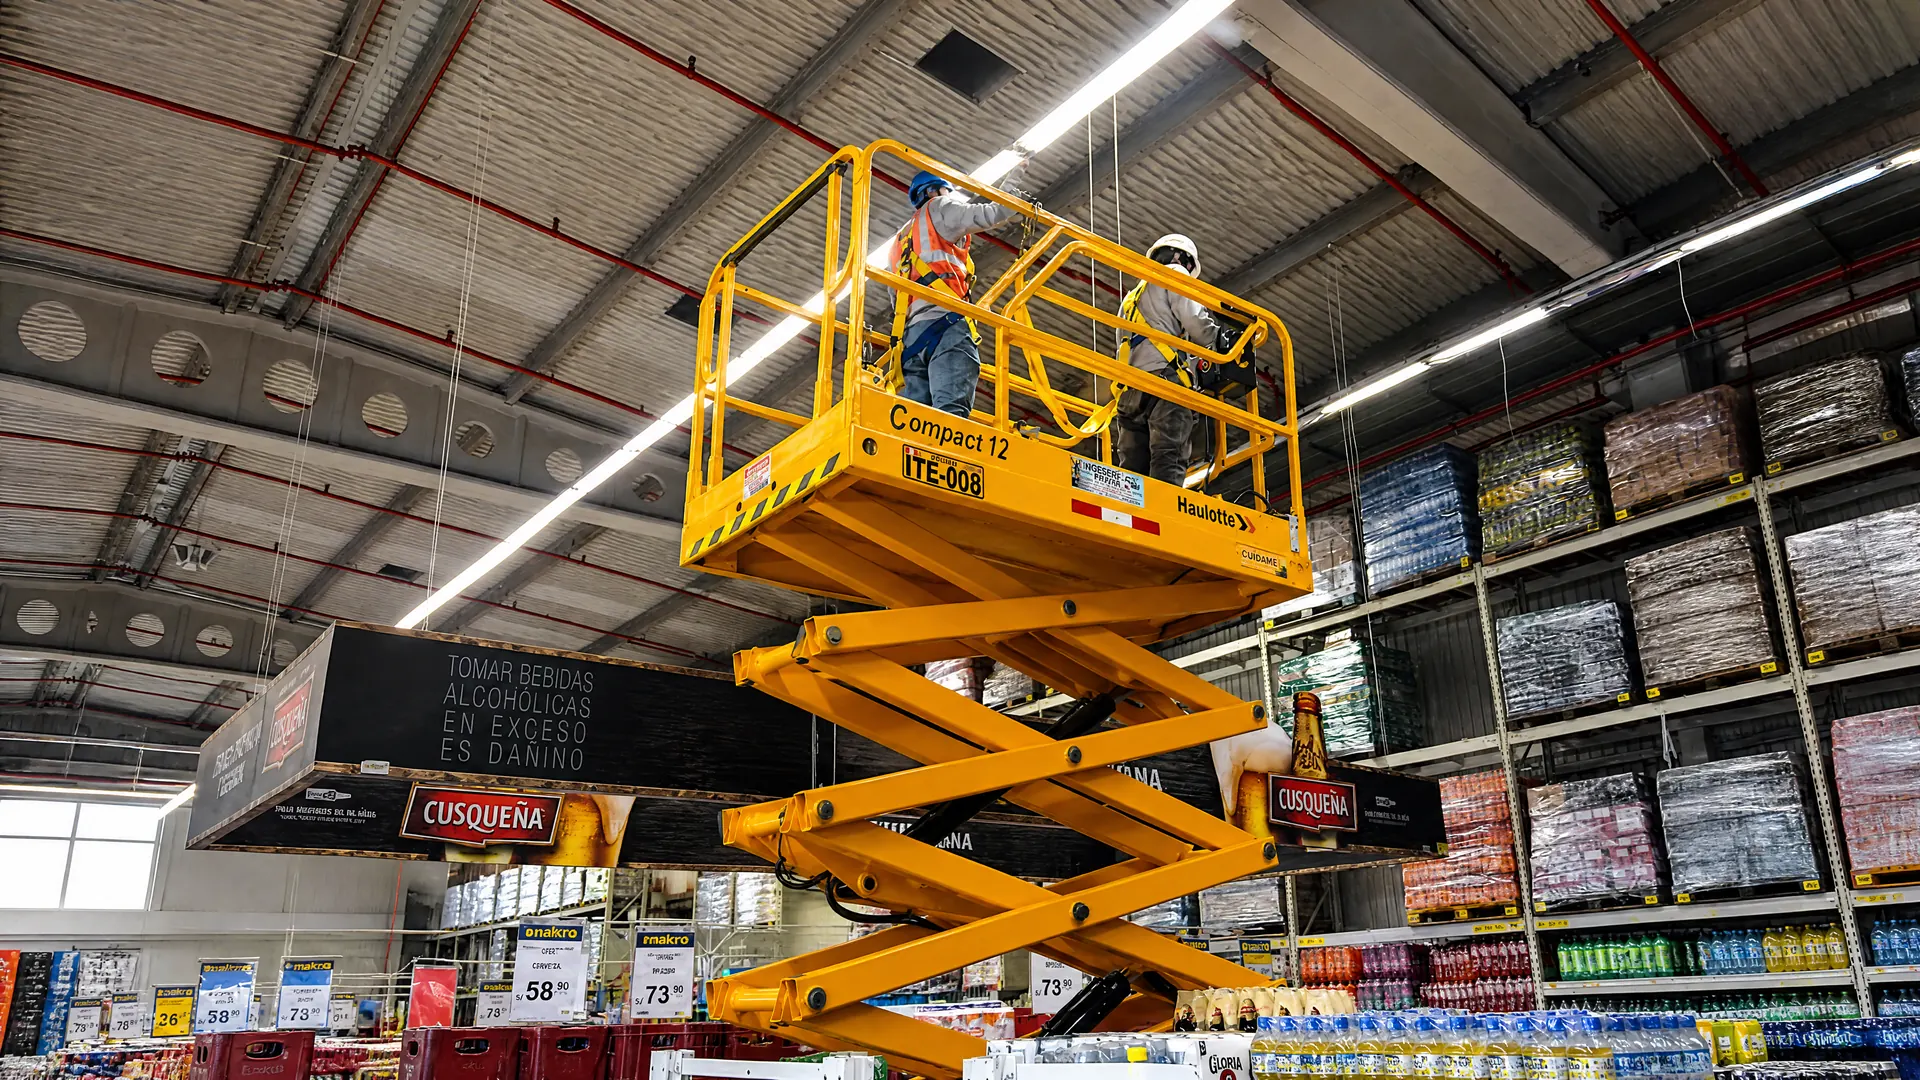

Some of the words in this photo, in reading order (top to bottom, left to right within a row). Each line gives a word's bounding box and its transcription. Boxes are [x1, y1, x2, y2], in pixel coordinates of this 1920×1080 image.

[890, 404, 983, 452] Compact
[990, 435, 1009, 460] 12
[906, 453, 981, 495] ITE-008
[1177, 495, 1235, 528] Haulotte
[1241, 549, 1278, 567] CUIDAME
[448, 654, 513, 683] TOMAR
[519, 663, 594, 693] BEBIDAS
[443, 682, 591, 718] ALCOHÓLICAS
[443, 709, 475, 735] EN
[491, 714, 586, 744] EXCESO
[440, 737, 471, 762] ES
[488, 740, 583, 771] DAÑINO
[423, 800, 544, 834] CUSQUEÑA
[1278, 788, 1350, 819] CUSQUEÑA
[526, 981, 553, 1001] 58
[557, 981, 570, 991] 90
[646, 985, 670, 1005] 73
[673, 985, 684, 994] 90
[1042, 979, 1062, 997] 73
[1063, 979, 1073, 987] 90
[1209, 1054, 1243, 1075] GLORIA
